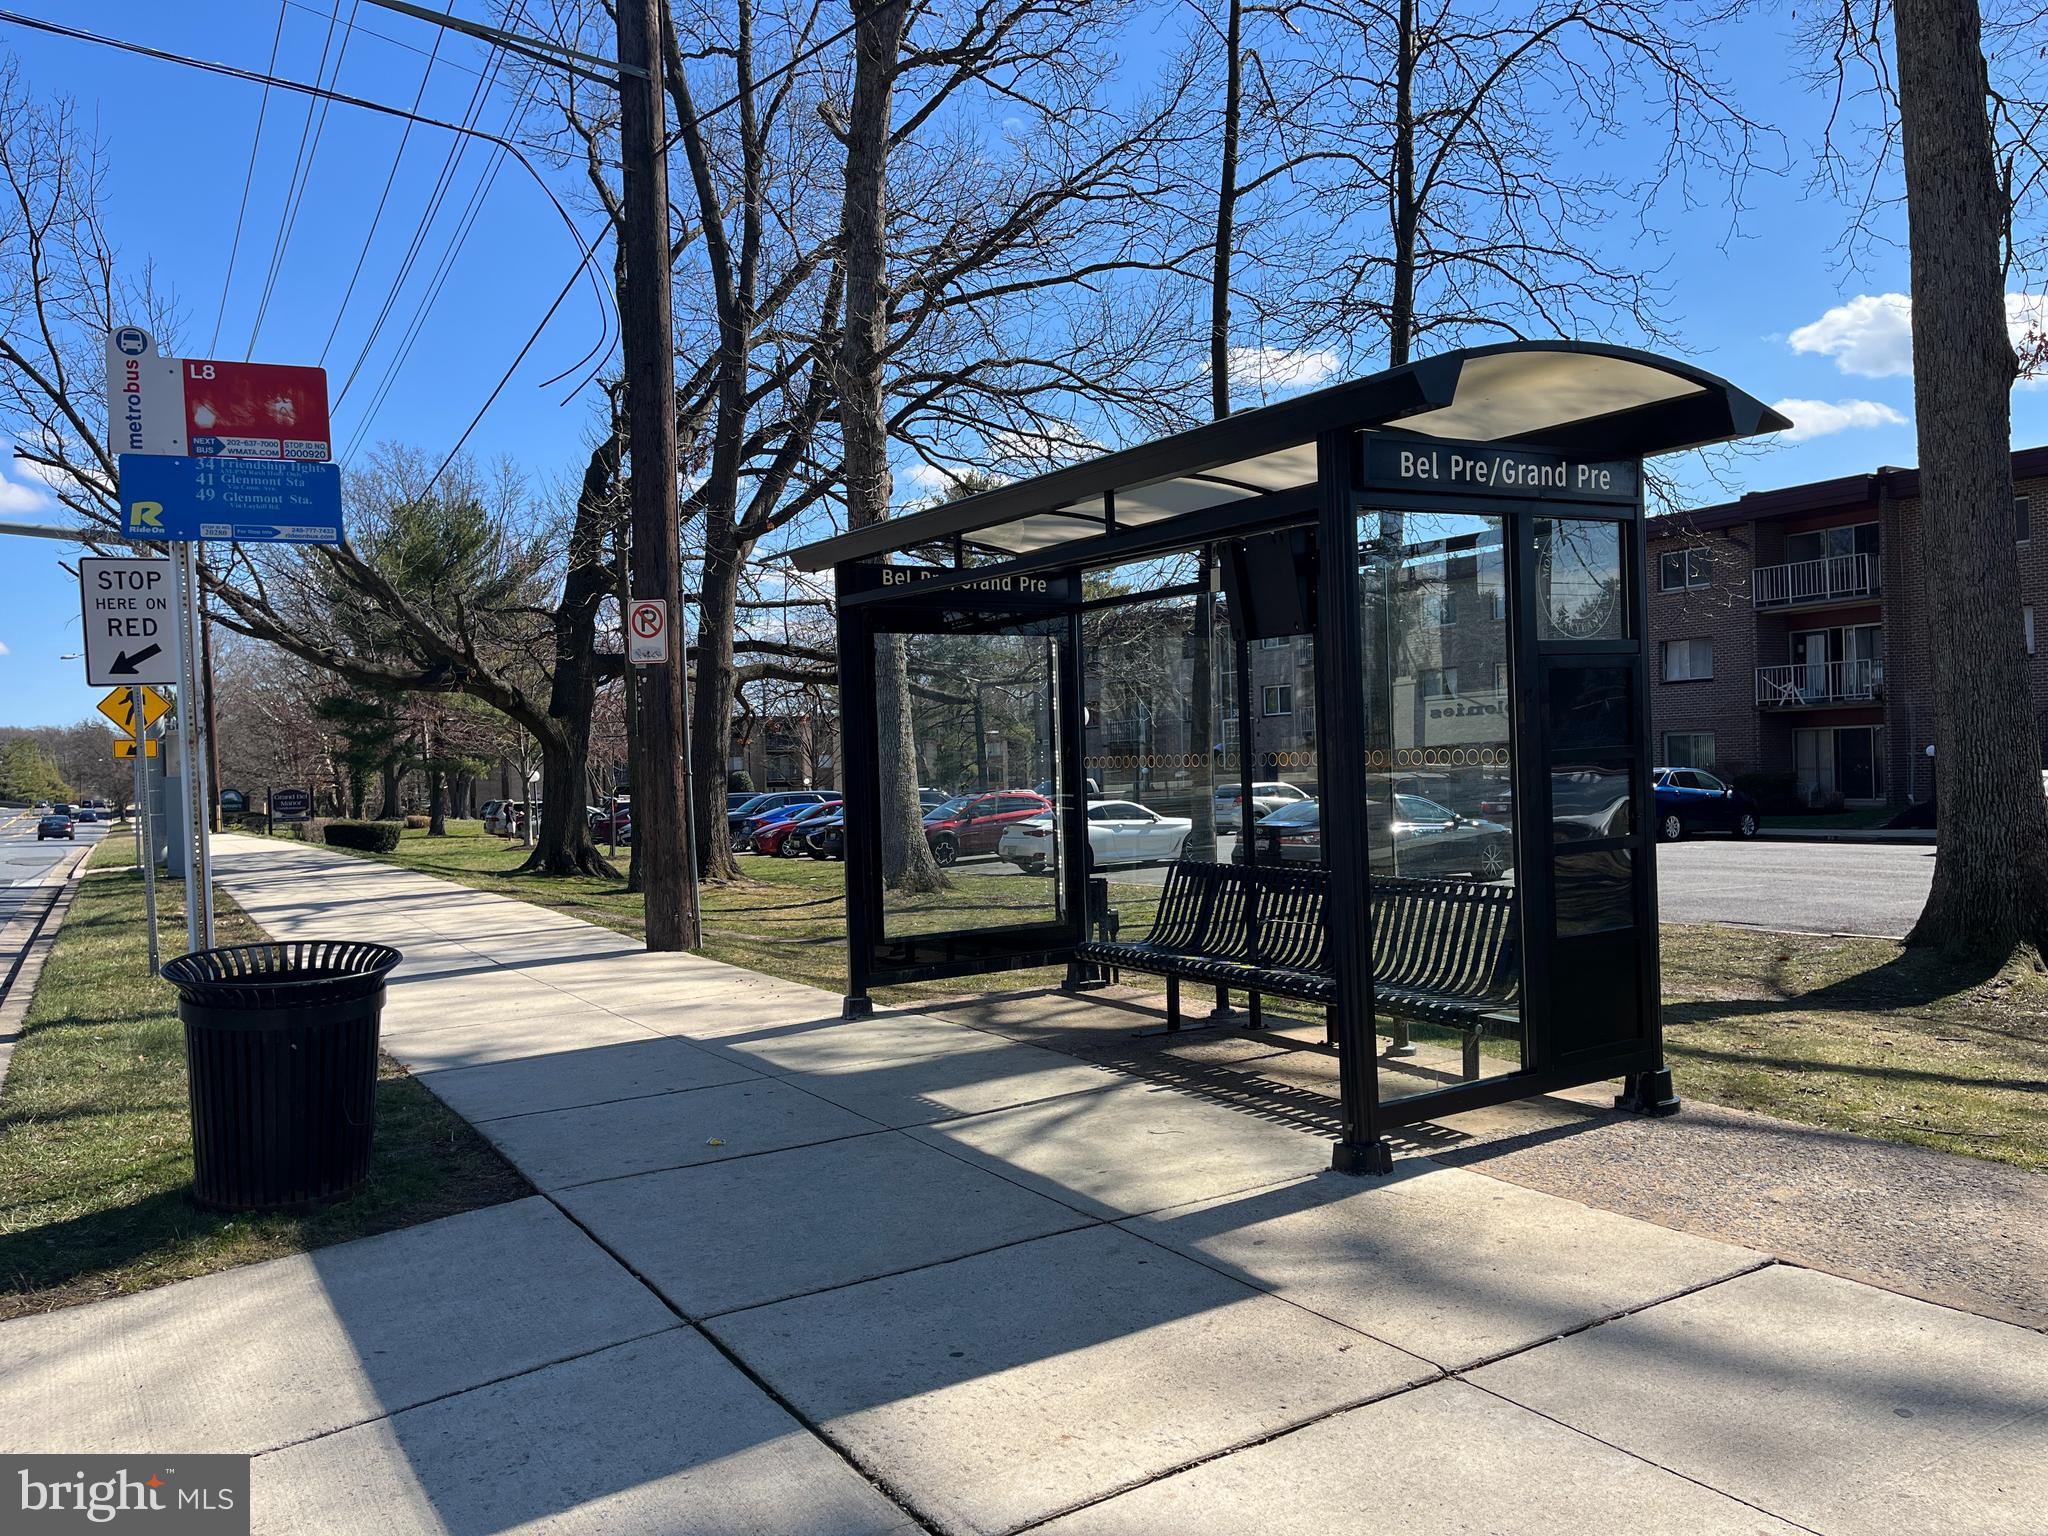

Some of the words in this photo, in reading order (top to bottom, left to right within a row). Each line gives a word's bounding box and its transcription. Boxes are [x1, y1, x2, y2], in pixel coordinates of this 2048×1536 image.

[190, 364, 216, 380] L8
[123, 359, 143, 450] metrobus
[196, 446, 214, 454] BUS
[226, 439, 279, 448] 202-637-7000
[305, 442, 313, 450] ID
[227, 448, 279, 457] WMATA.COM
[285, 449, 326, 459] 2000920
[195, 458, 215, 470] 34
[220, 458, 286, 475] Friendship
[290, 462, 326, 474] Hghts
[1400, 451, 1439, 480] Bel
[1450, 454, 1567, 488] Pre/Grand
[1577, 464, 1611, 490] Pre
[195, 473, 214, 486] 41
[220, 473, 282, 486] Glenmont
[195, 488, 216, 501] 49
[222, 492, 283, 504] Glenmont
[290, 494, 313, 505] Sta.
[130, 501, 164, 527] R
[98, 570, 162, 590] STOP
[882, 569, 911, 586] Bel
[1020, 576, 1047, 593] Pre
[95, 598, 137, 610] HERE
[146, 598, 167, 610] ON
[107, 618, 158, 637] RED
